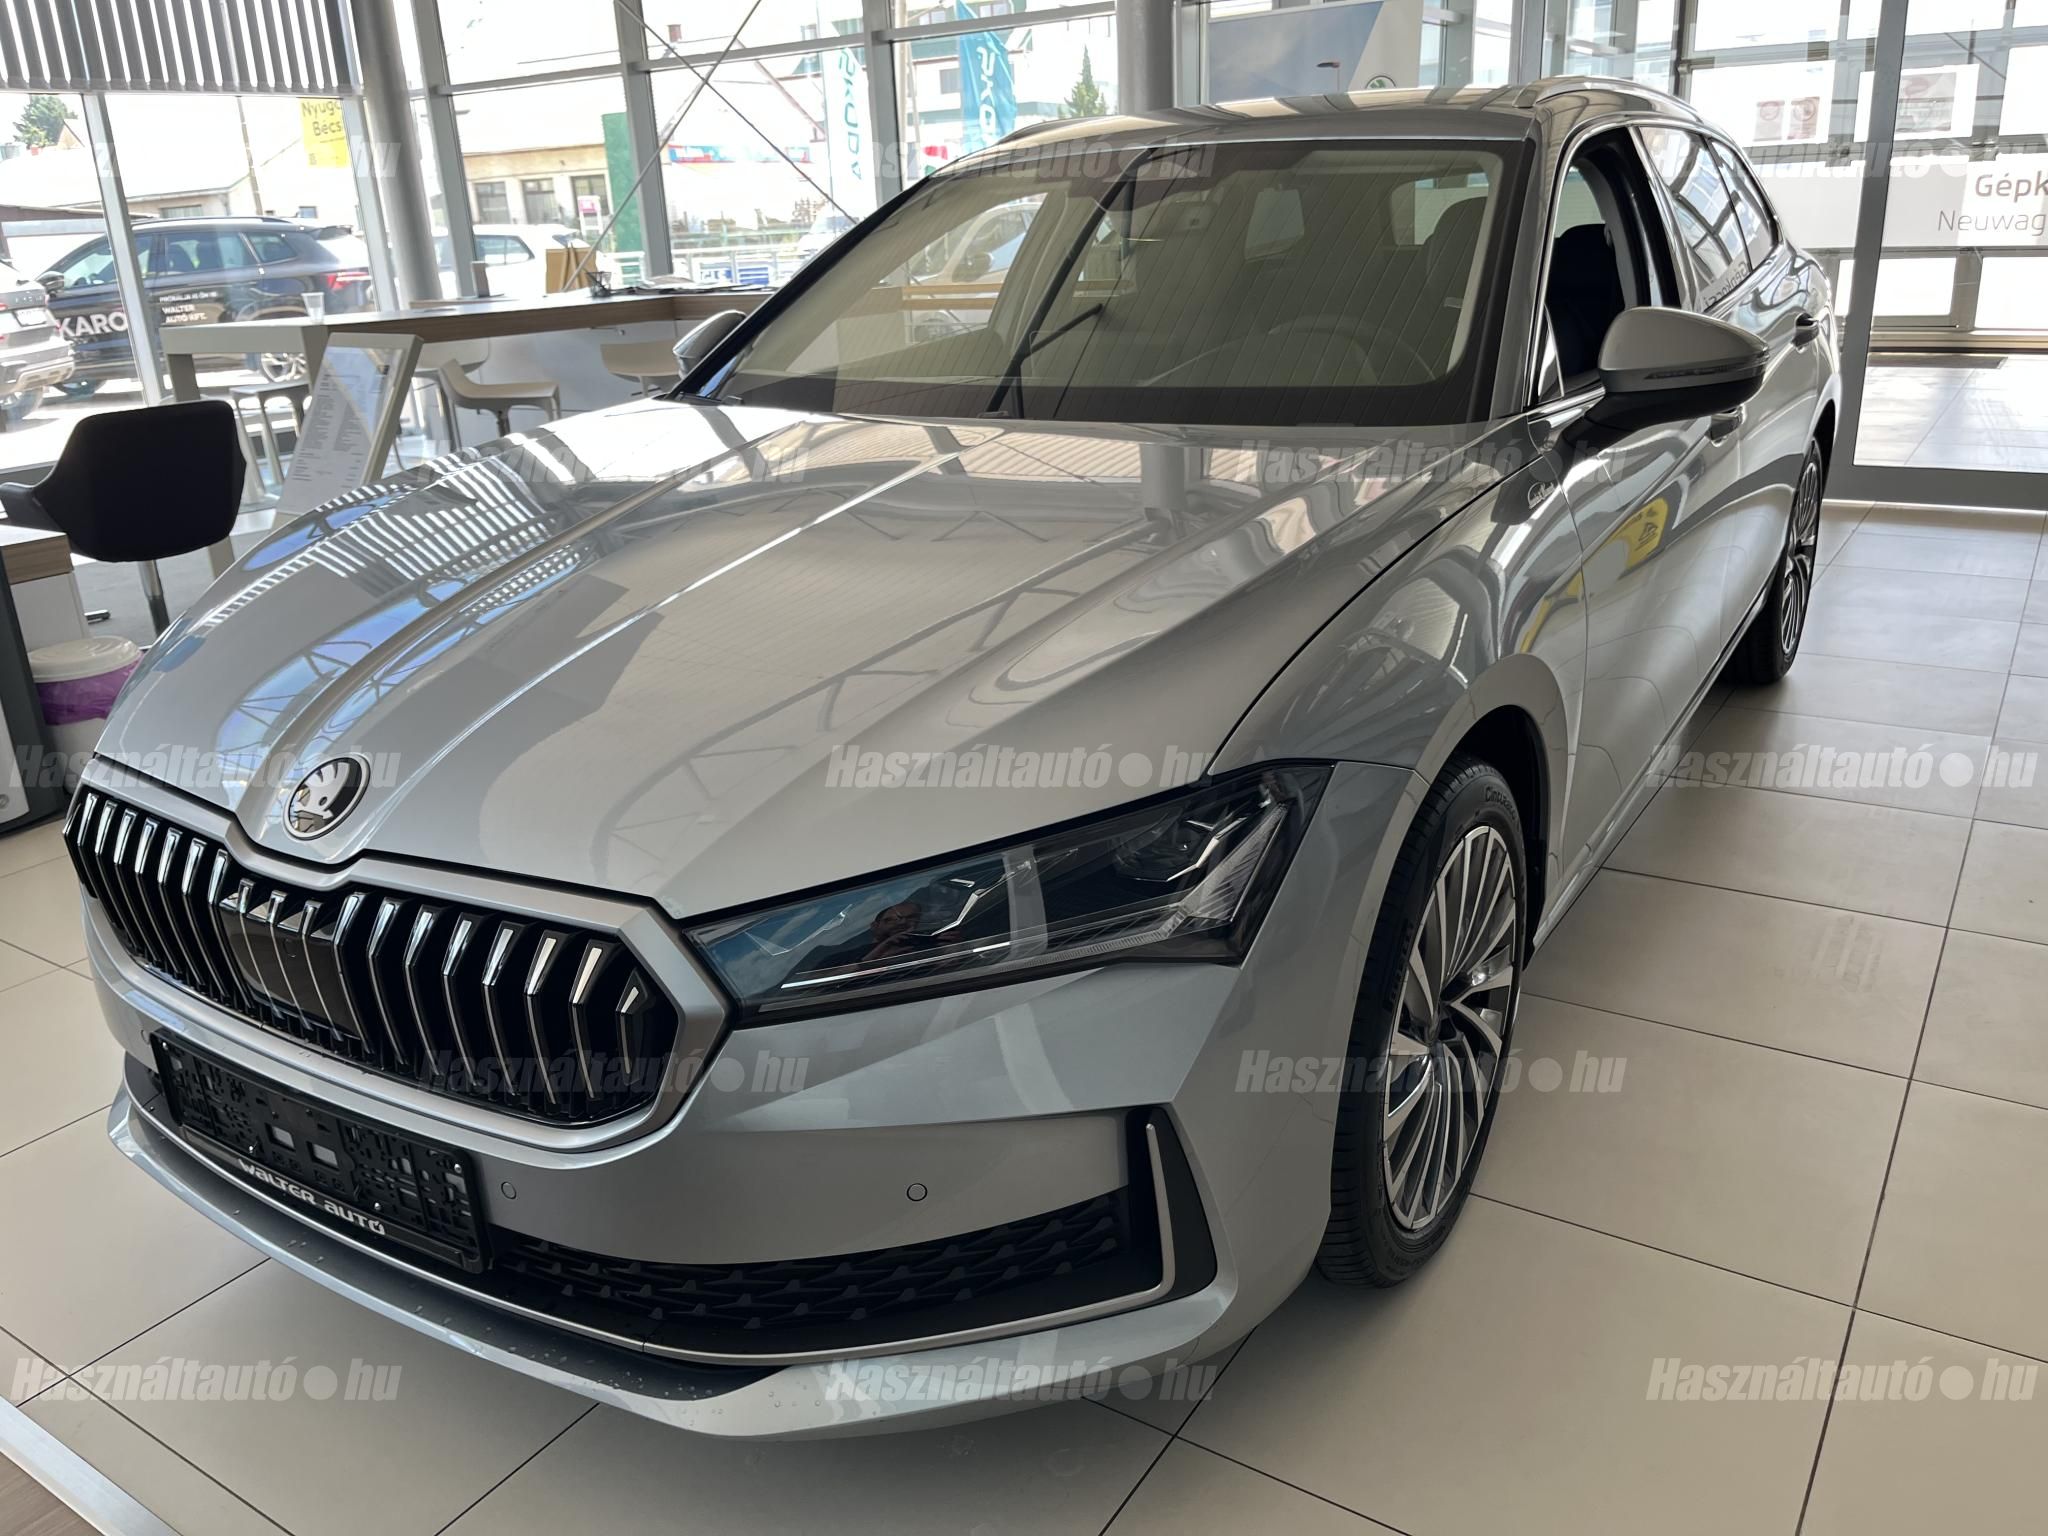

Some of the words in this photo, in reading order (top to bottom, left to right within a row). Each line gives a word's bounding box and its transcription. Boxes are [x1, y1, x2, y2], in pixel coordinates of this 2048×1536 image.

[1975, 170, 2048, 204] Gépk
[1938, 209, 2047, 237] Neuwag
[57, 311, 129, 337] KARO
